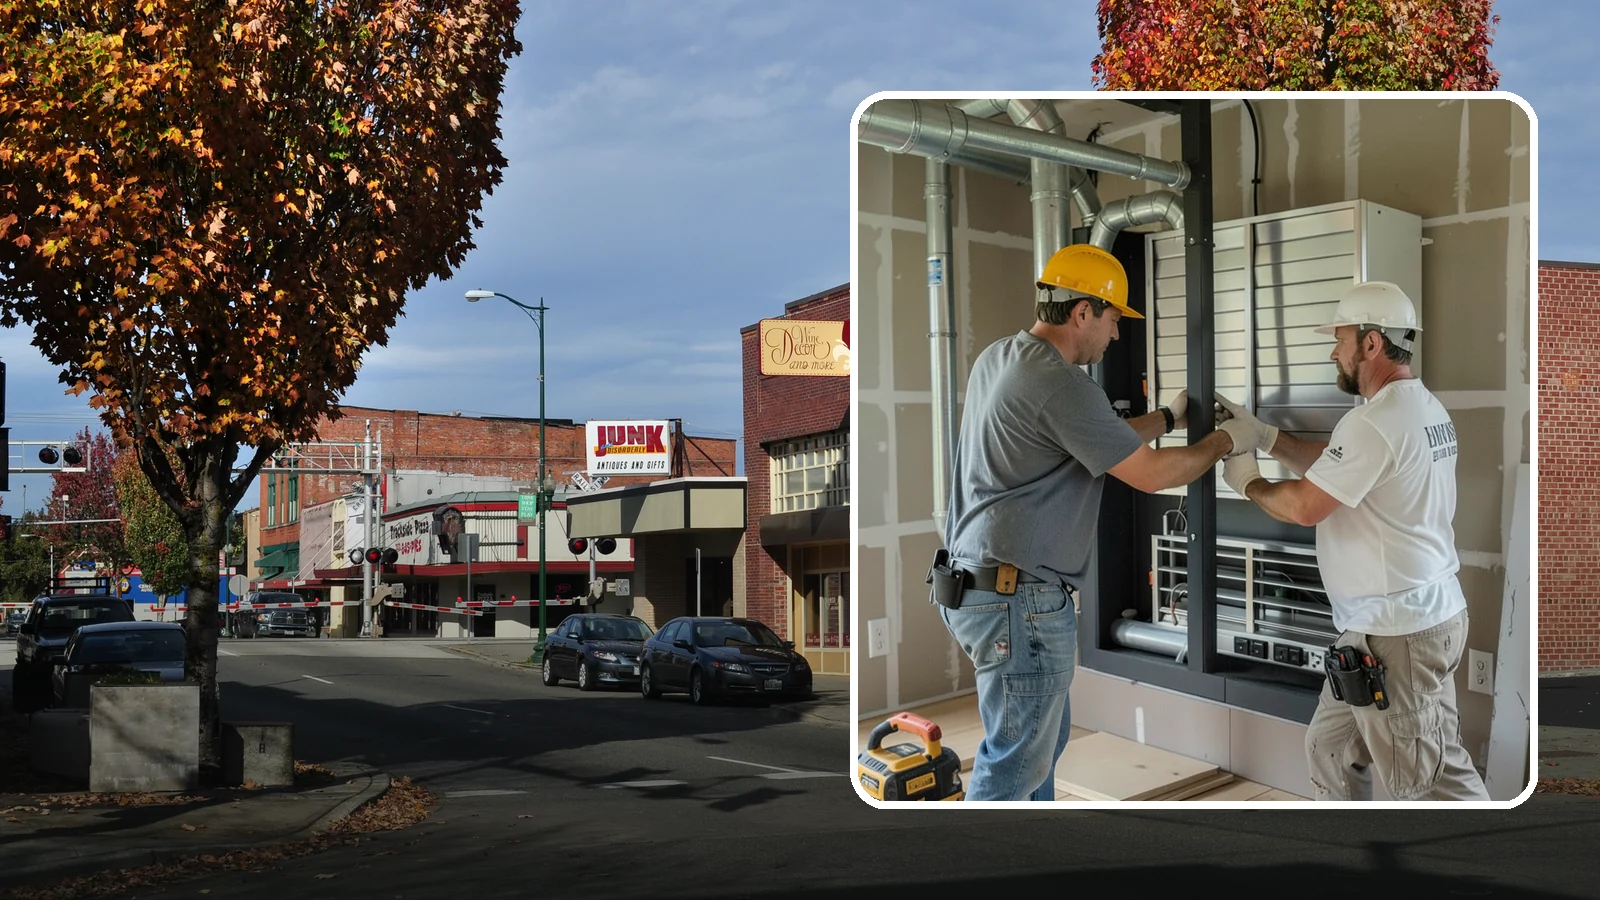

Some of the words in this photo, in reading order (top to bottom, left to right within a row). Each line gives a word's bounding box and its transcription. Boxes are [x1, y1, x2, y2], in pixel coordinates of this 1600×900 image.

[595, 425, 665, 457] JUNK
[607, 445, 646, 454] DISORDERLY
[596, 461, 628, 470] ANTIQUES
[631, 461, 644, 469] AND
[646, 460, 665, 470] GIFTS
[390, 521, 413, 539] Trackside
[415, 520, 429, 534] Pizza
